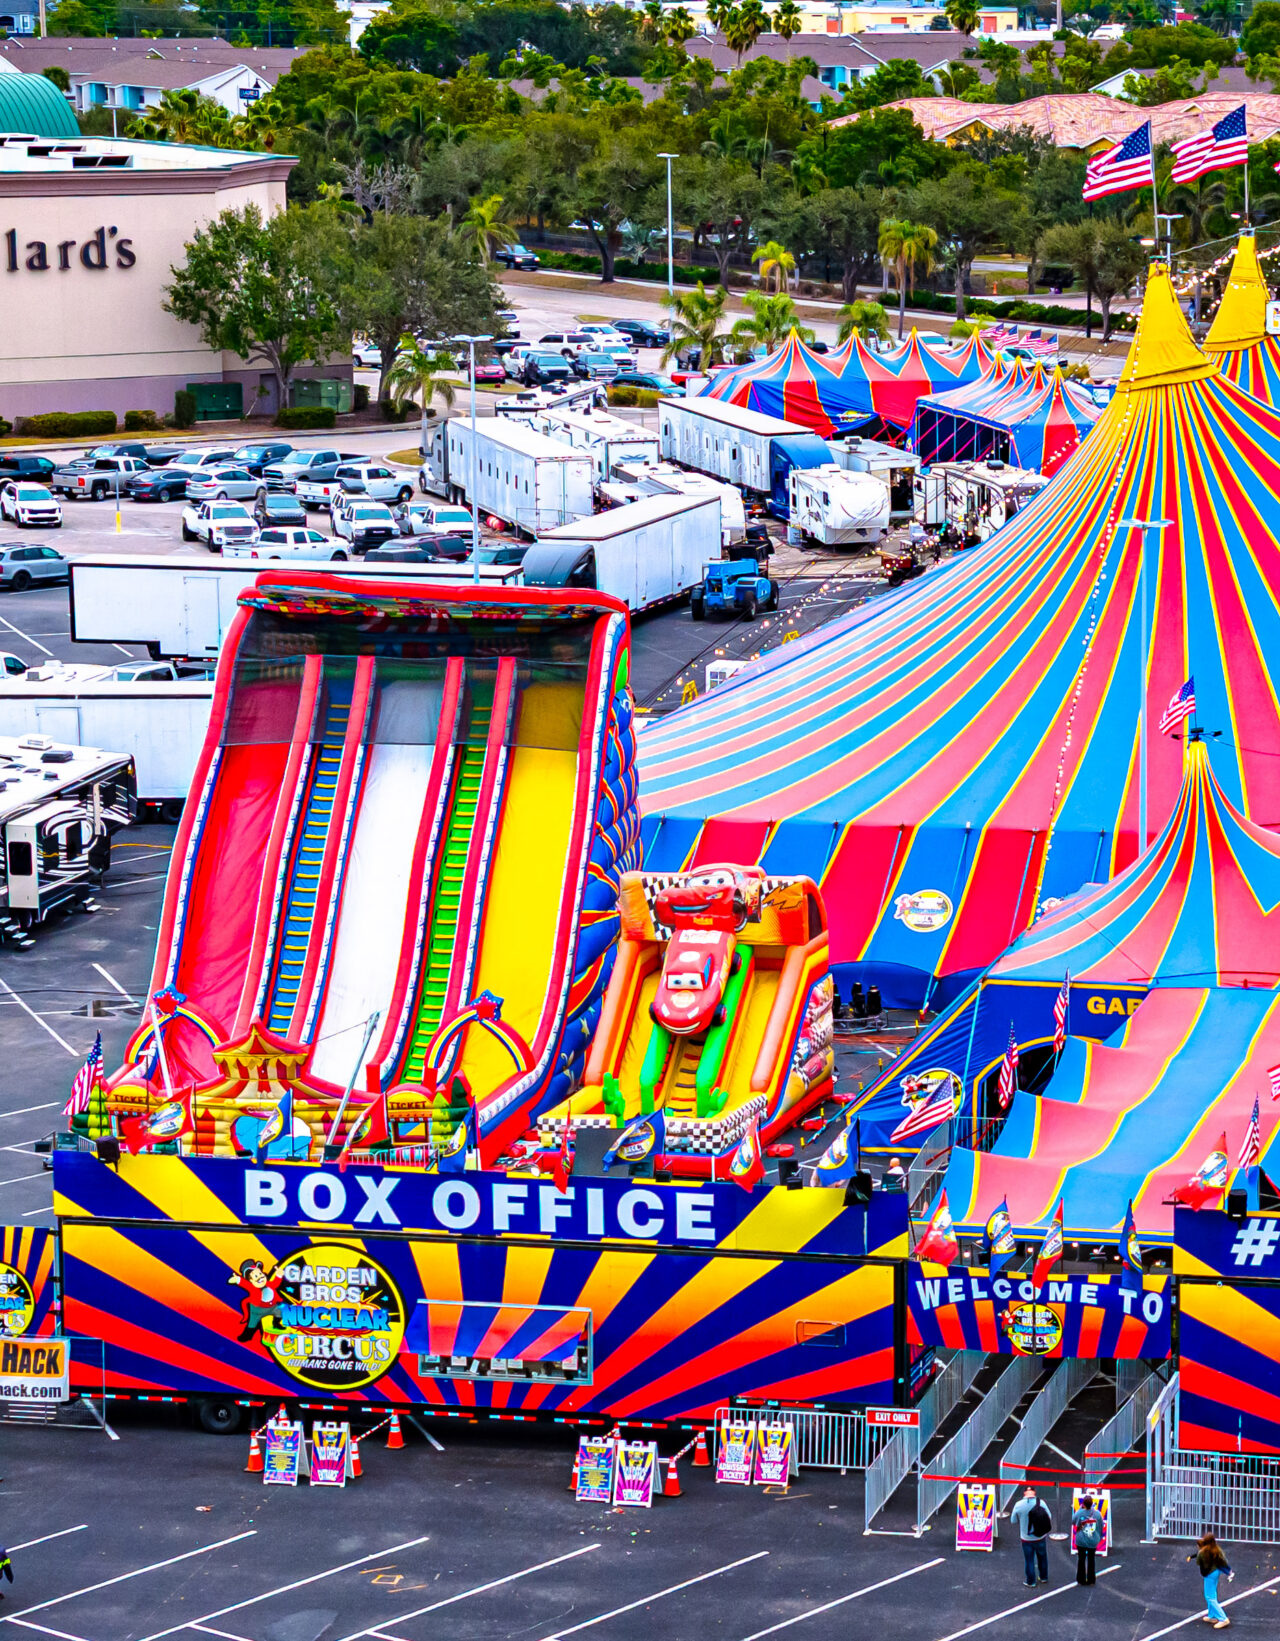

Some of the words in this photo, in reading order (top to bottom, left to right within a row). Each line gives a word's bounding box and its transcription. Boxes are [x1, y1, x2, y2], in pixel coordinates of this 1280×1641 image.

[5, 226, 136, 272] lard's
[389, 1100, 427, 1110] TICKET
[245, 1169, 400, 1225] BOX
[432, 1179, 716, 1241] OFFICE
[284, 1264, 377, 1287] GARDEN
[300, 1284, 362, 1303] BROS
[915, 1277, 1099, 1311] WELCOME
[1118, 1288, 1164, 1324] TO
[280, 1304, 392, 1332] NUCLEAR
[1, 1342, 60, 1375] HACK
[275, 1333, 391, 1361] CIRCUS
[327, 1360, 354, 1371] GONE
[875, 1412, 891, 1422] EXIT
[892, 1413, 911, 1423] ONLY
